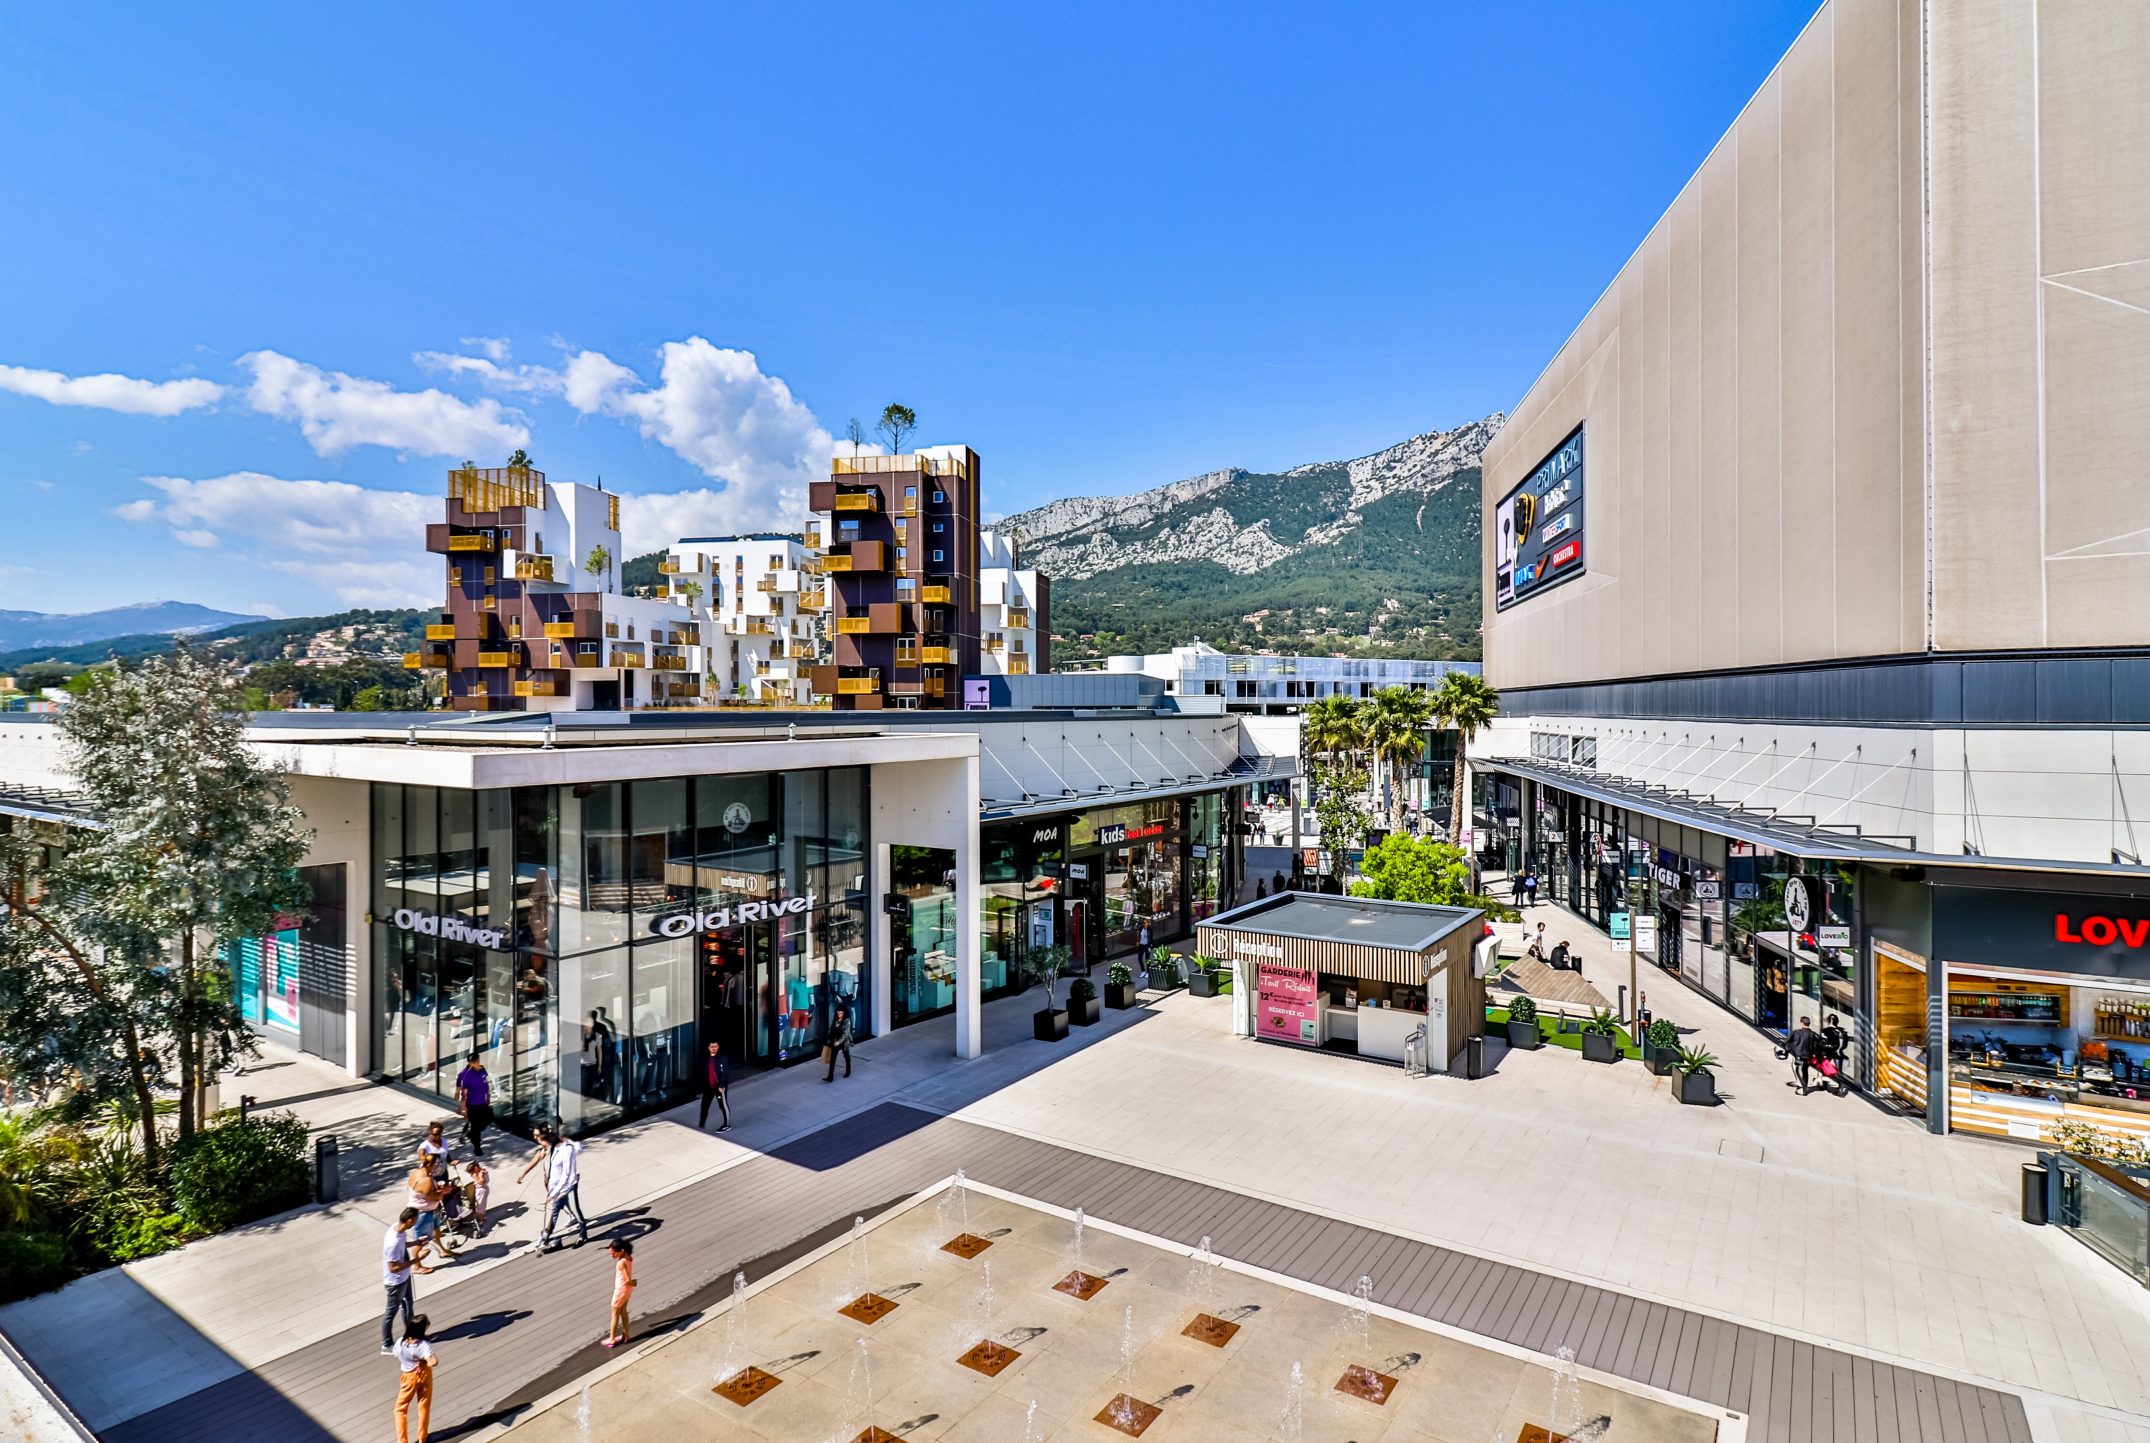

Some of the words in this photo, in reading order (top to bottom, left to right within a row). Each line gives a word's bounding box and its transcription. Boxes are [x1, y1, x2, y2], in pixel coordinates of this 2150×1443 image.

[1537, 440, 1579, 495] PRIMARK
[1033, 827, 1058, 843] MOA
[1101, 826, 1125, 845] kids
[1648, 862, 1680, 891] TIGER
[660, 907, 730, 938] Old
[737, 895, 817, 924] River
[395, 909, 439, 935] Old
[441, 917, 504, 949] River
[1821, 932, 1849, 940] LOVEBIO
[1233, 938, 1282, 960] Réception
[1261, 966, 1301, 979] GARDERIE
[1261, 976, 1280, 988] Tarif
